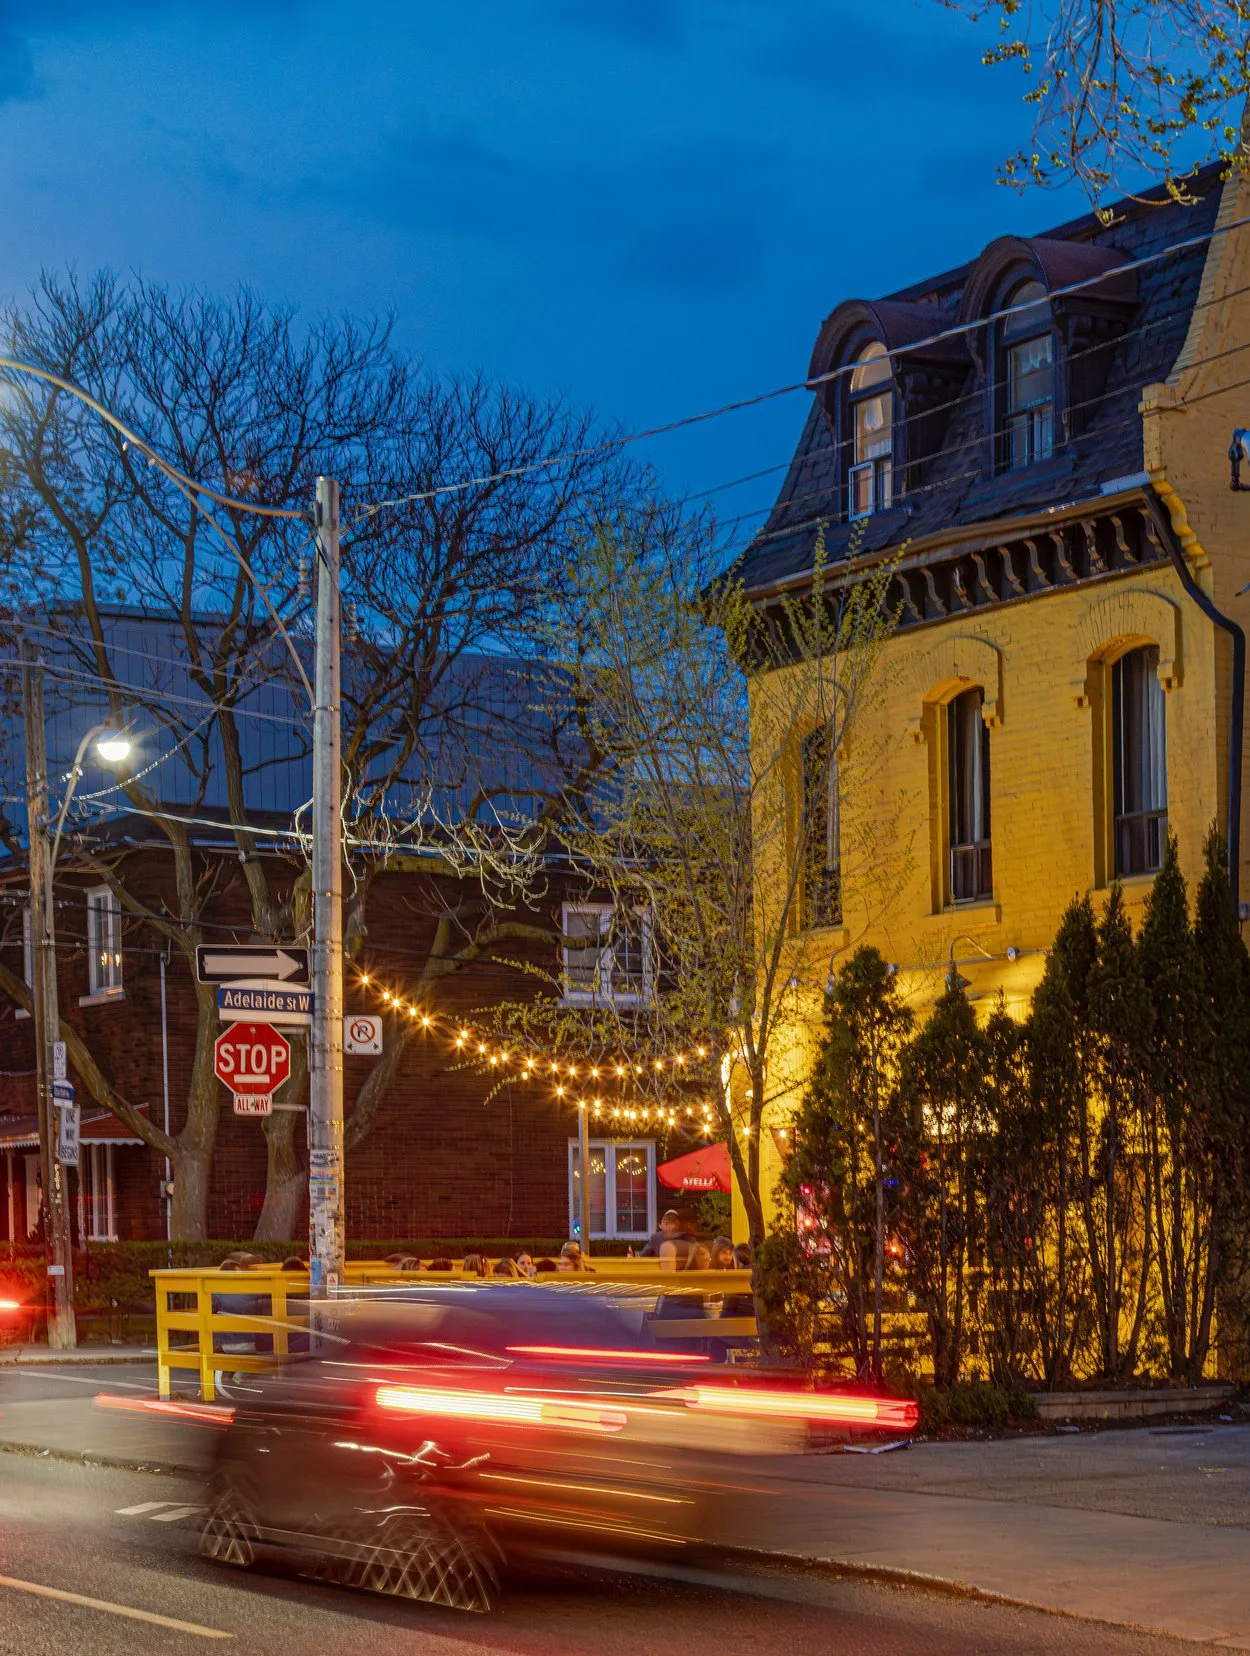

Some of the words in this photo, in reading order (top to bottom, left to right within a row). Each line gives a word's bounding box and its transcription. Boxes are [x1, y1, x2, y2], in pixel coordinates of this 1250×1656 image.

[224, 990, 284, 1010] Adelaide
[299, 994, 310, 1011] W
[218, 1042, 287, 1075] STOP
